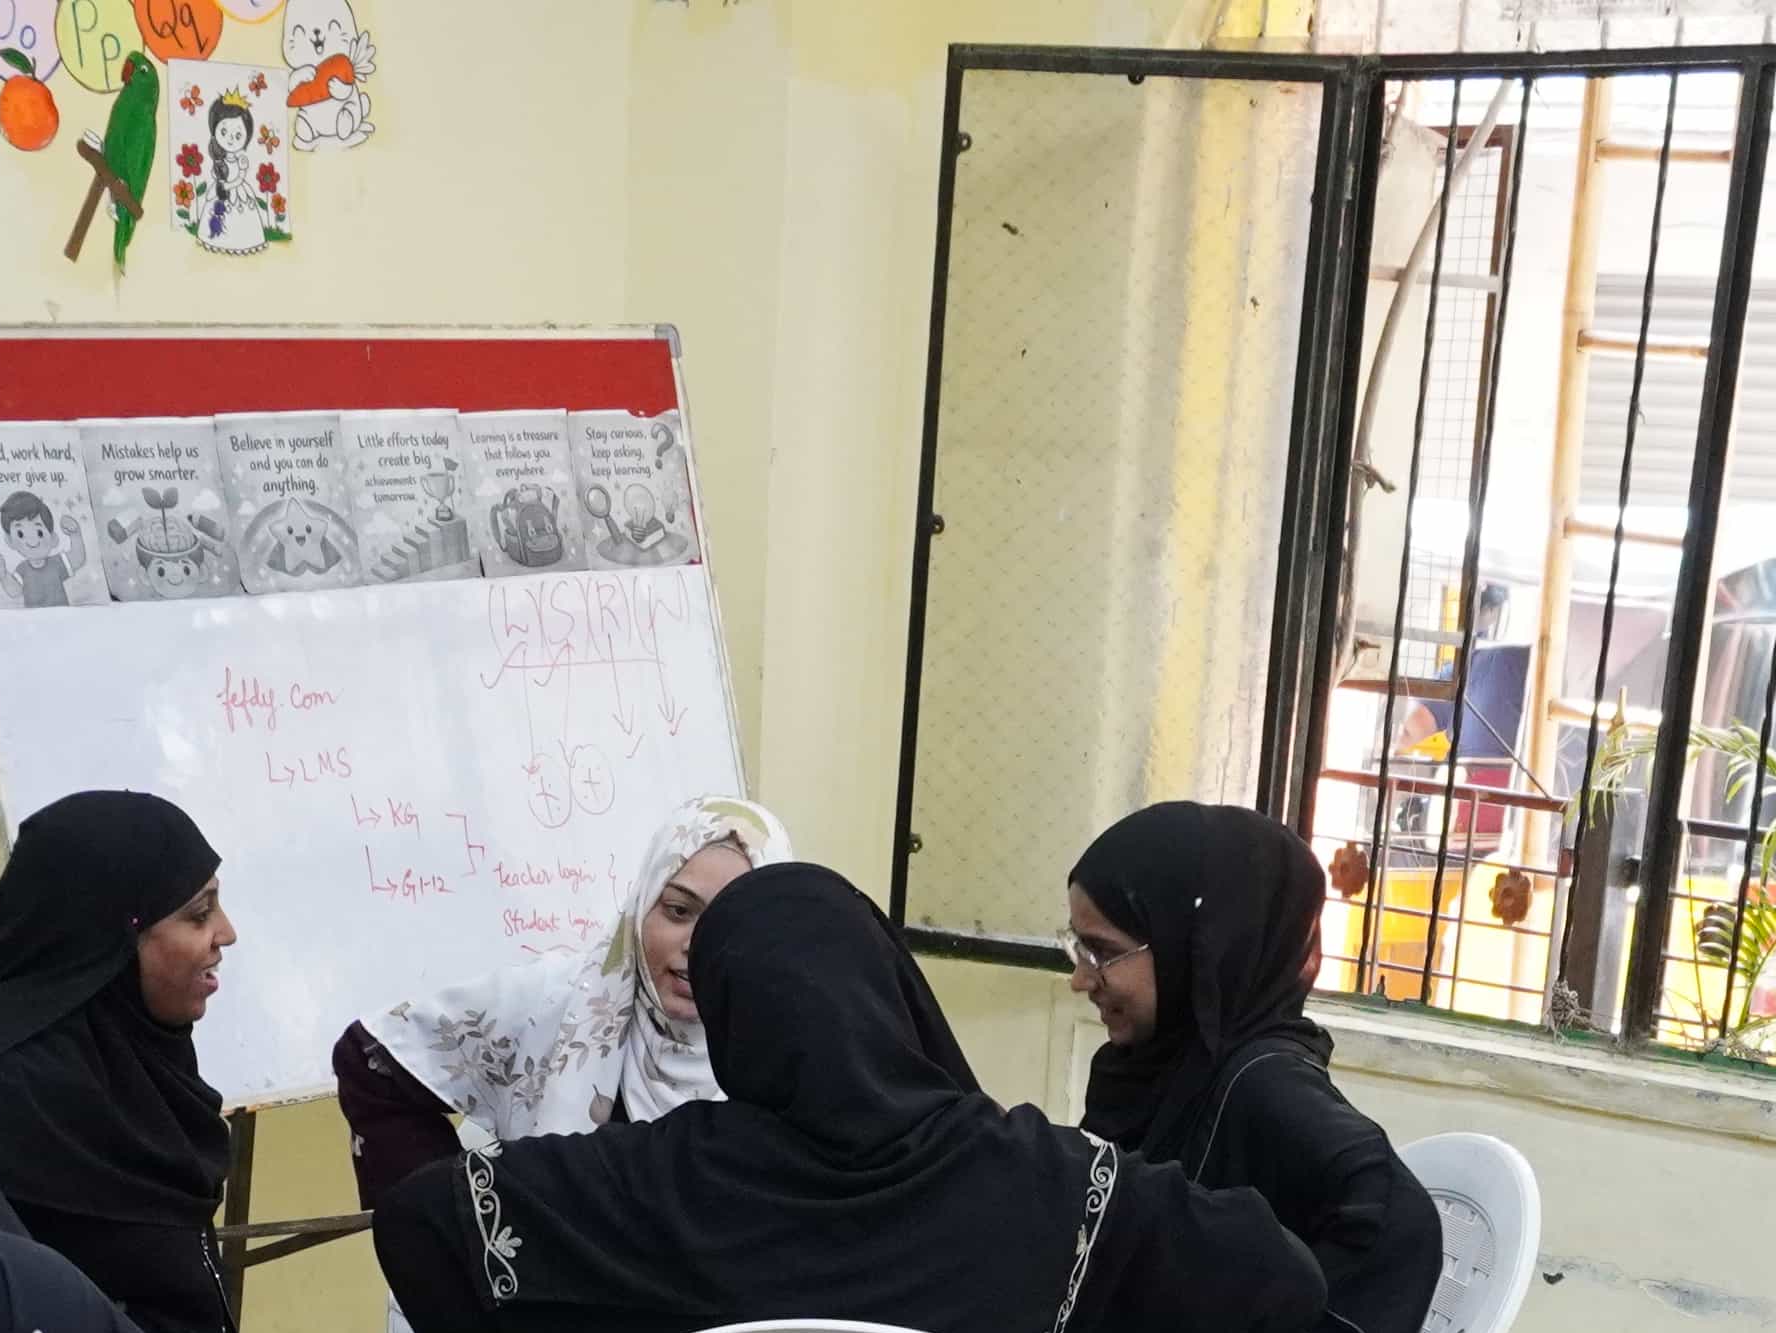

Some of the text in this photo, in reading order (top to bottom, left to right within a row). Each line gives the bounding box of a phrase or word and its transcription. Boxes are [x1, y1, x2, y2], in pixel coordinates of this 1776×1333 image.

[229, 430, 334, 453] Believe in yourself
[357, 430, 449, 450] Little efforts today
[507, 430, 515, 441] is
[585, 426, 608, 442] Stay
[11, 441, 41, 461] work
[42, 441, 76, 463] hard,
[101, 441, 200, 464] Mistakes help us
[377, 451, 432, 469] create big
[591, 445, 611, 460] keep
[250, 453, 329, 474] and you can do
[590, 463, 612, 477] keep
[24, 470, 49, 488] give
[51, 472, 68, 488] up.
[114, 468, 199, 488] grow smarter.
[262, 477, 320, 497] anything.
